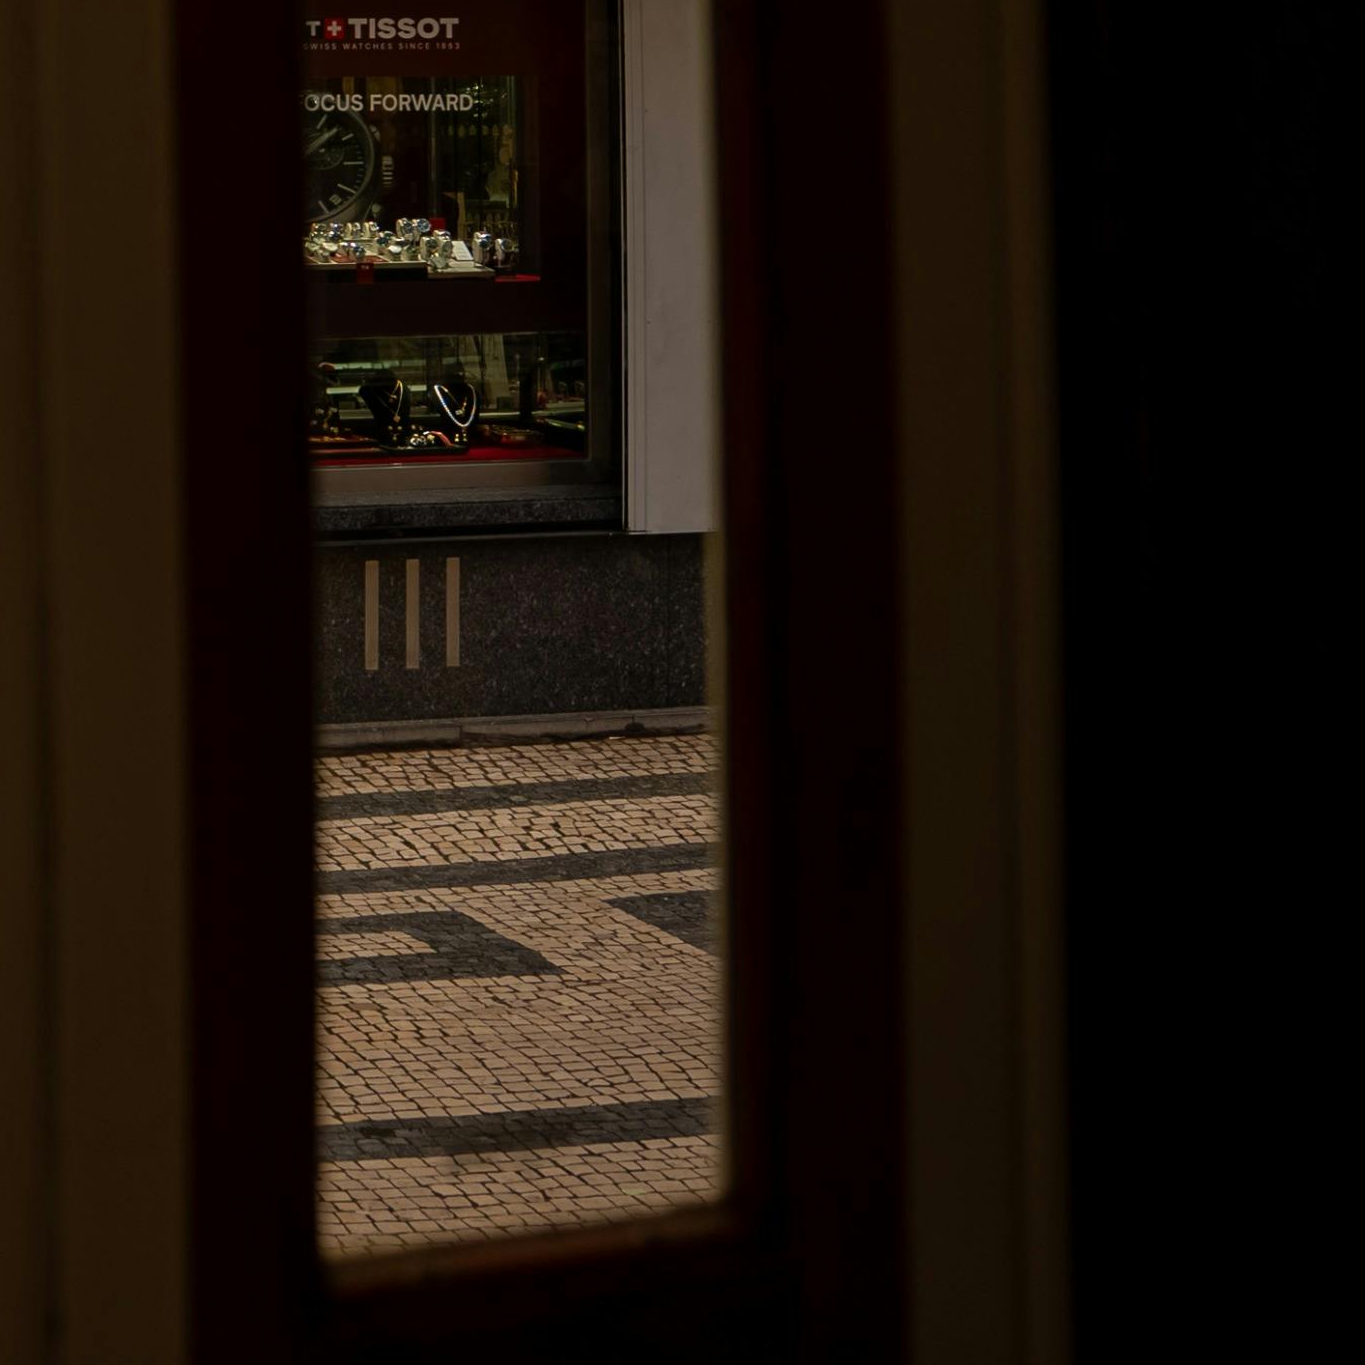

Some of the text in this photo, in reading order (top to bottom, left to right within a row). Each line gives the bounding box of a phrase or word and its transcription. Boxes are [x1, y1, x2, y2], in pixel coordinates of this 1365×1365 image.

[347, 16, 460, 40] TISSOT
[343, 42, 393, 51] WATCHES
[398, 42, 430, 51] SINCE
[369, 93, 474, 113] FORWARD
